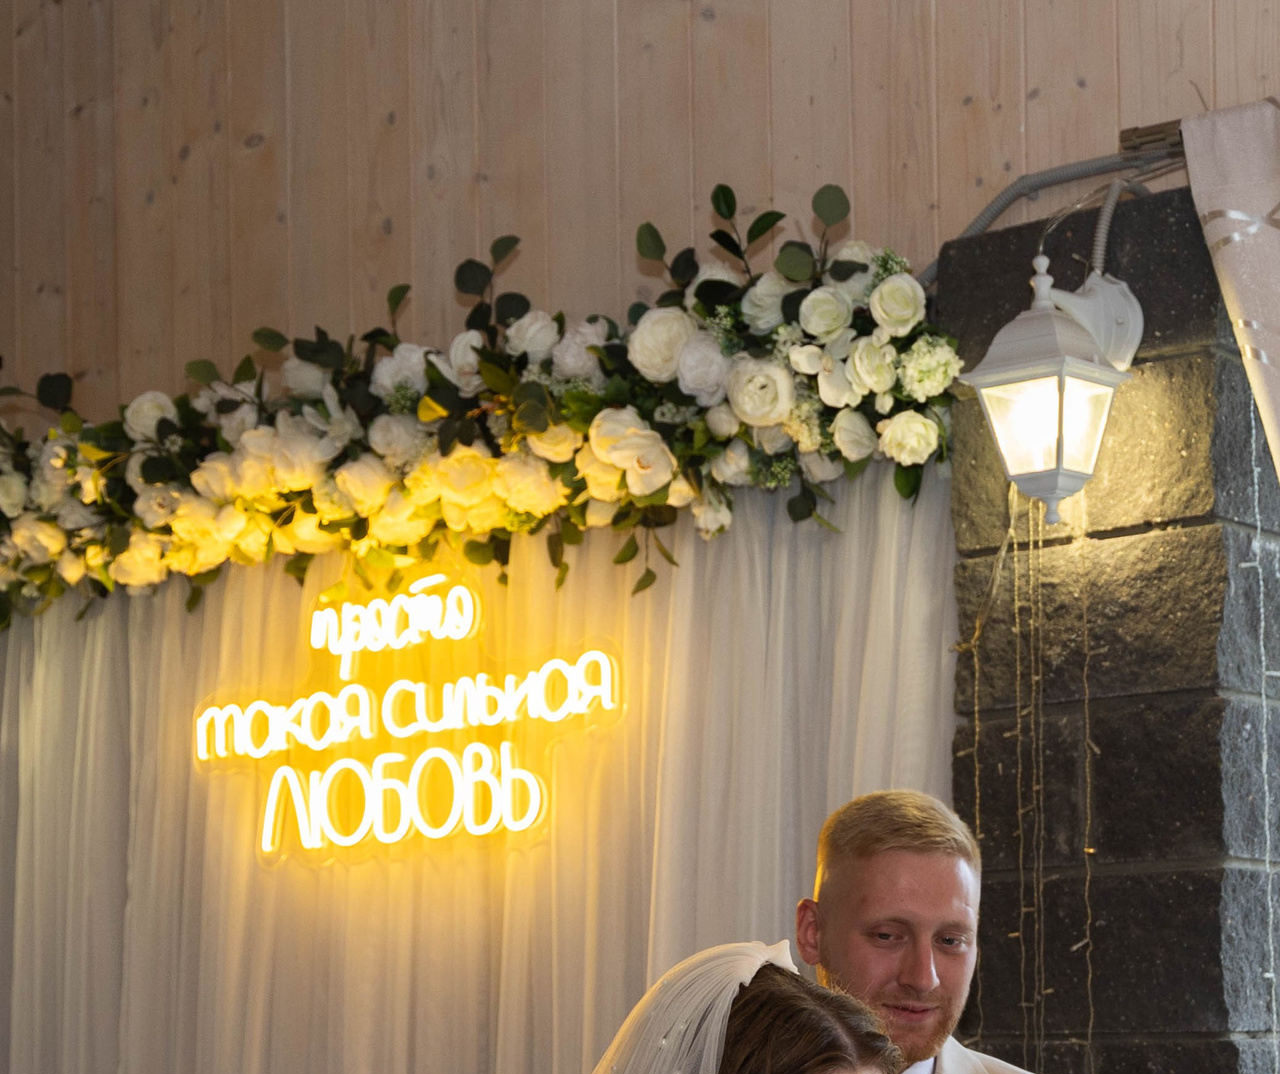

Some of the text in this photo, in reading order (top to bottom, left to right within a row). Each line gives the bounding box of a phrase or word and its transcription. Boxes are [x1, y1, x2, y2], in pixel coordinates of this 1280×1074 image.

[311, 574, 475, 681] просто
[197, 650, 614, 760] такая сильная
[261, 741, 541, 852] ЛЮБОВЬ
